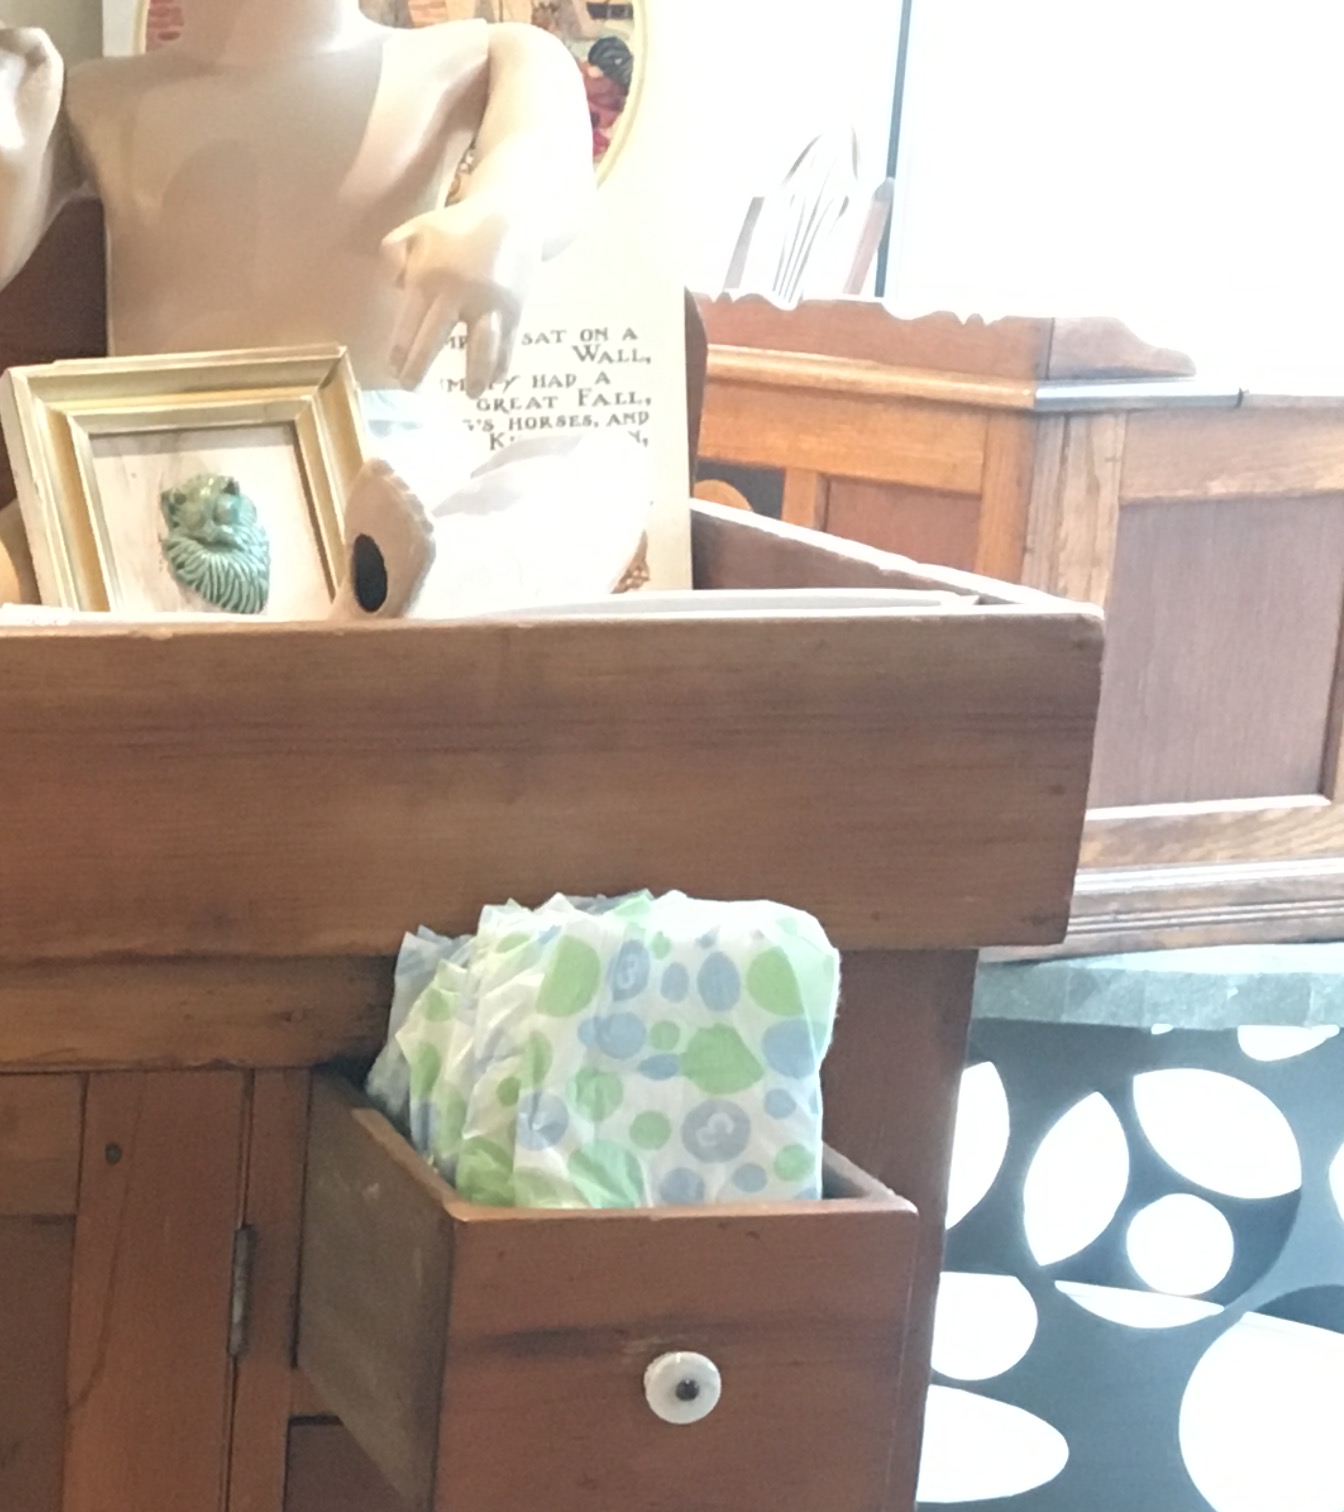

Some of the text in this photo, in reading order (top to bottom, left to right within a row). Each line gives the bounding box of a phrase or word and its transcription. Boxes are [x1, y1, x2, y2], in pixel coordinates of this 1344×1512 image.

[521, 327, 638, 346] SAT ON A
[532, 373, 577, 389] HAD
[594, 371, 611, 385] A
[476, 396, 559, 415] GREAT
[509, 414, 599, 431] HORSES,
[606, 410, 650, 427] AND
